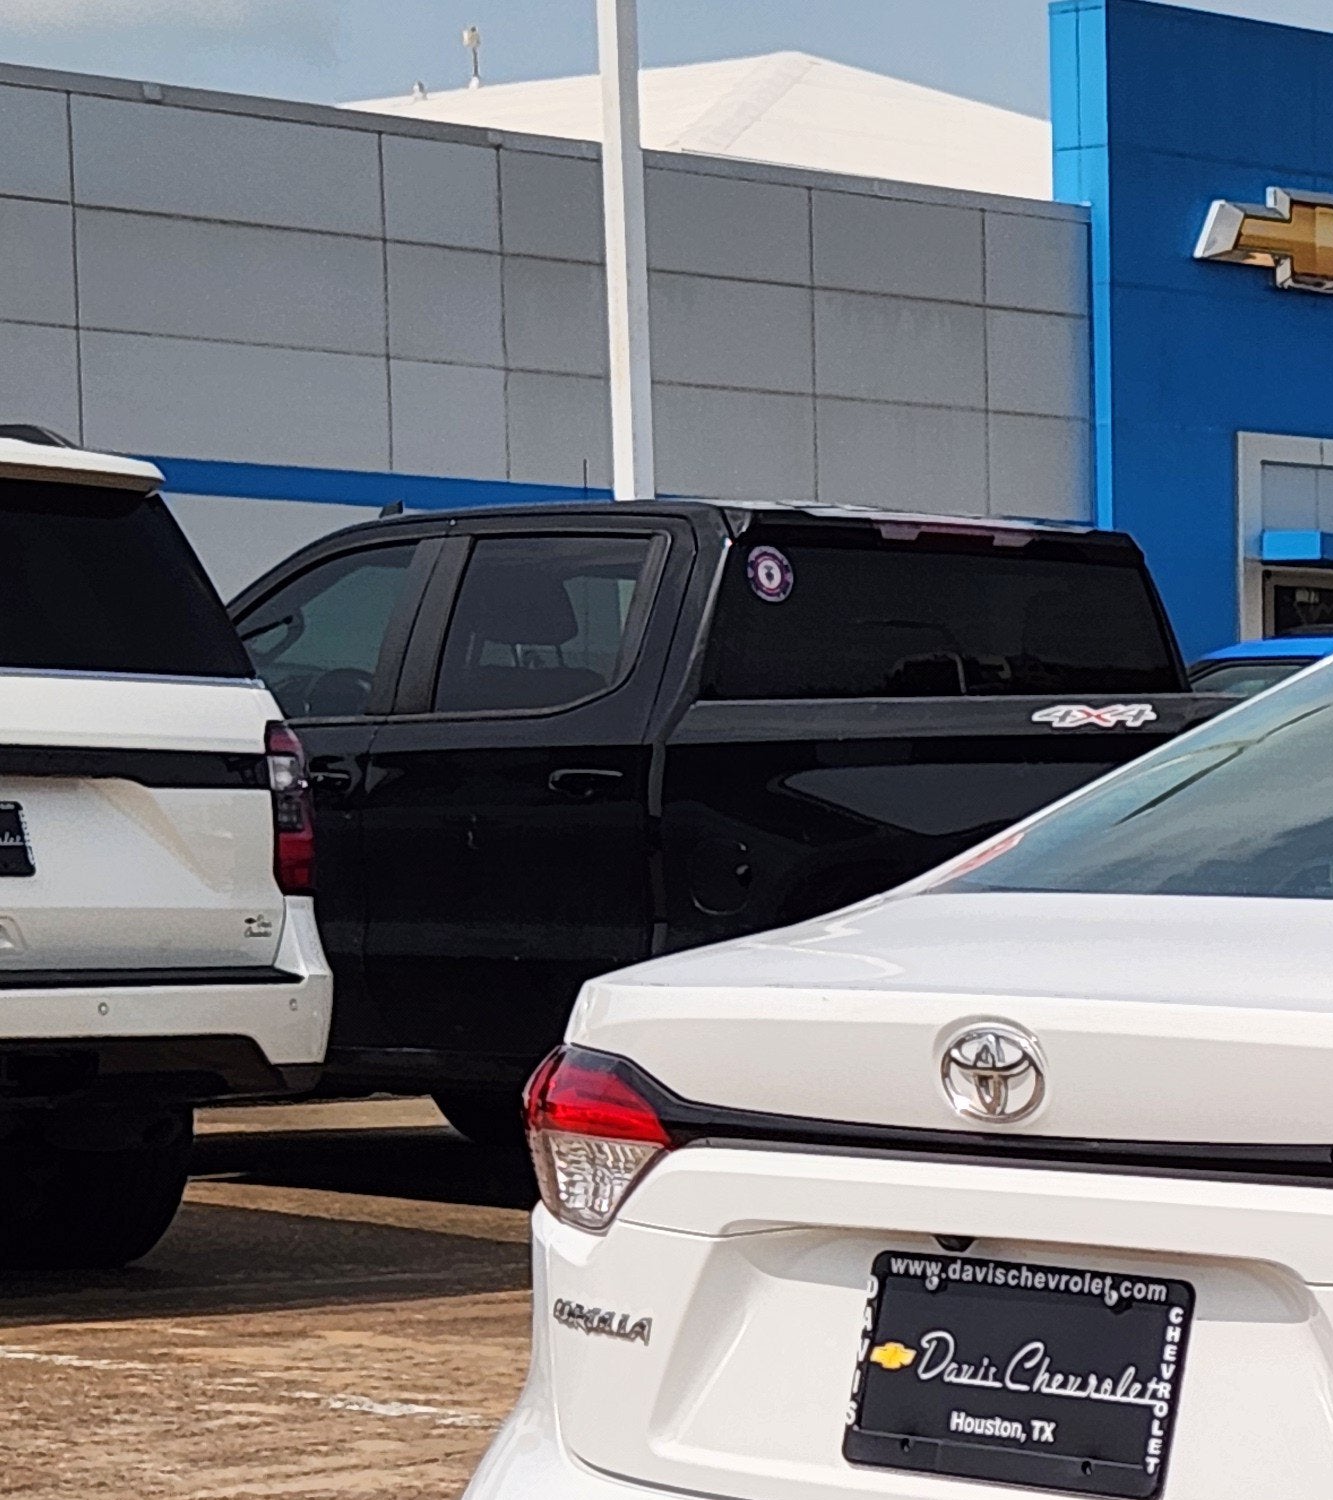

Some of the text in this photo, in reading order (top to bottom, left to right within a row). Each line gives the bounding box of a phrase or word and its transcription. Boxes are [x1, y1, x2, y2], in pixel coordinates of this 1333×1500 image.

[890, 1256, 1168, 1303] www.davischevroletcom
[917, 1330, 1160, 1405] Davis Chevrolet
[1144, 1306, 1185, 1475] CHEVROLET
[950, 1411, 1056, 1443] Houston, TX
